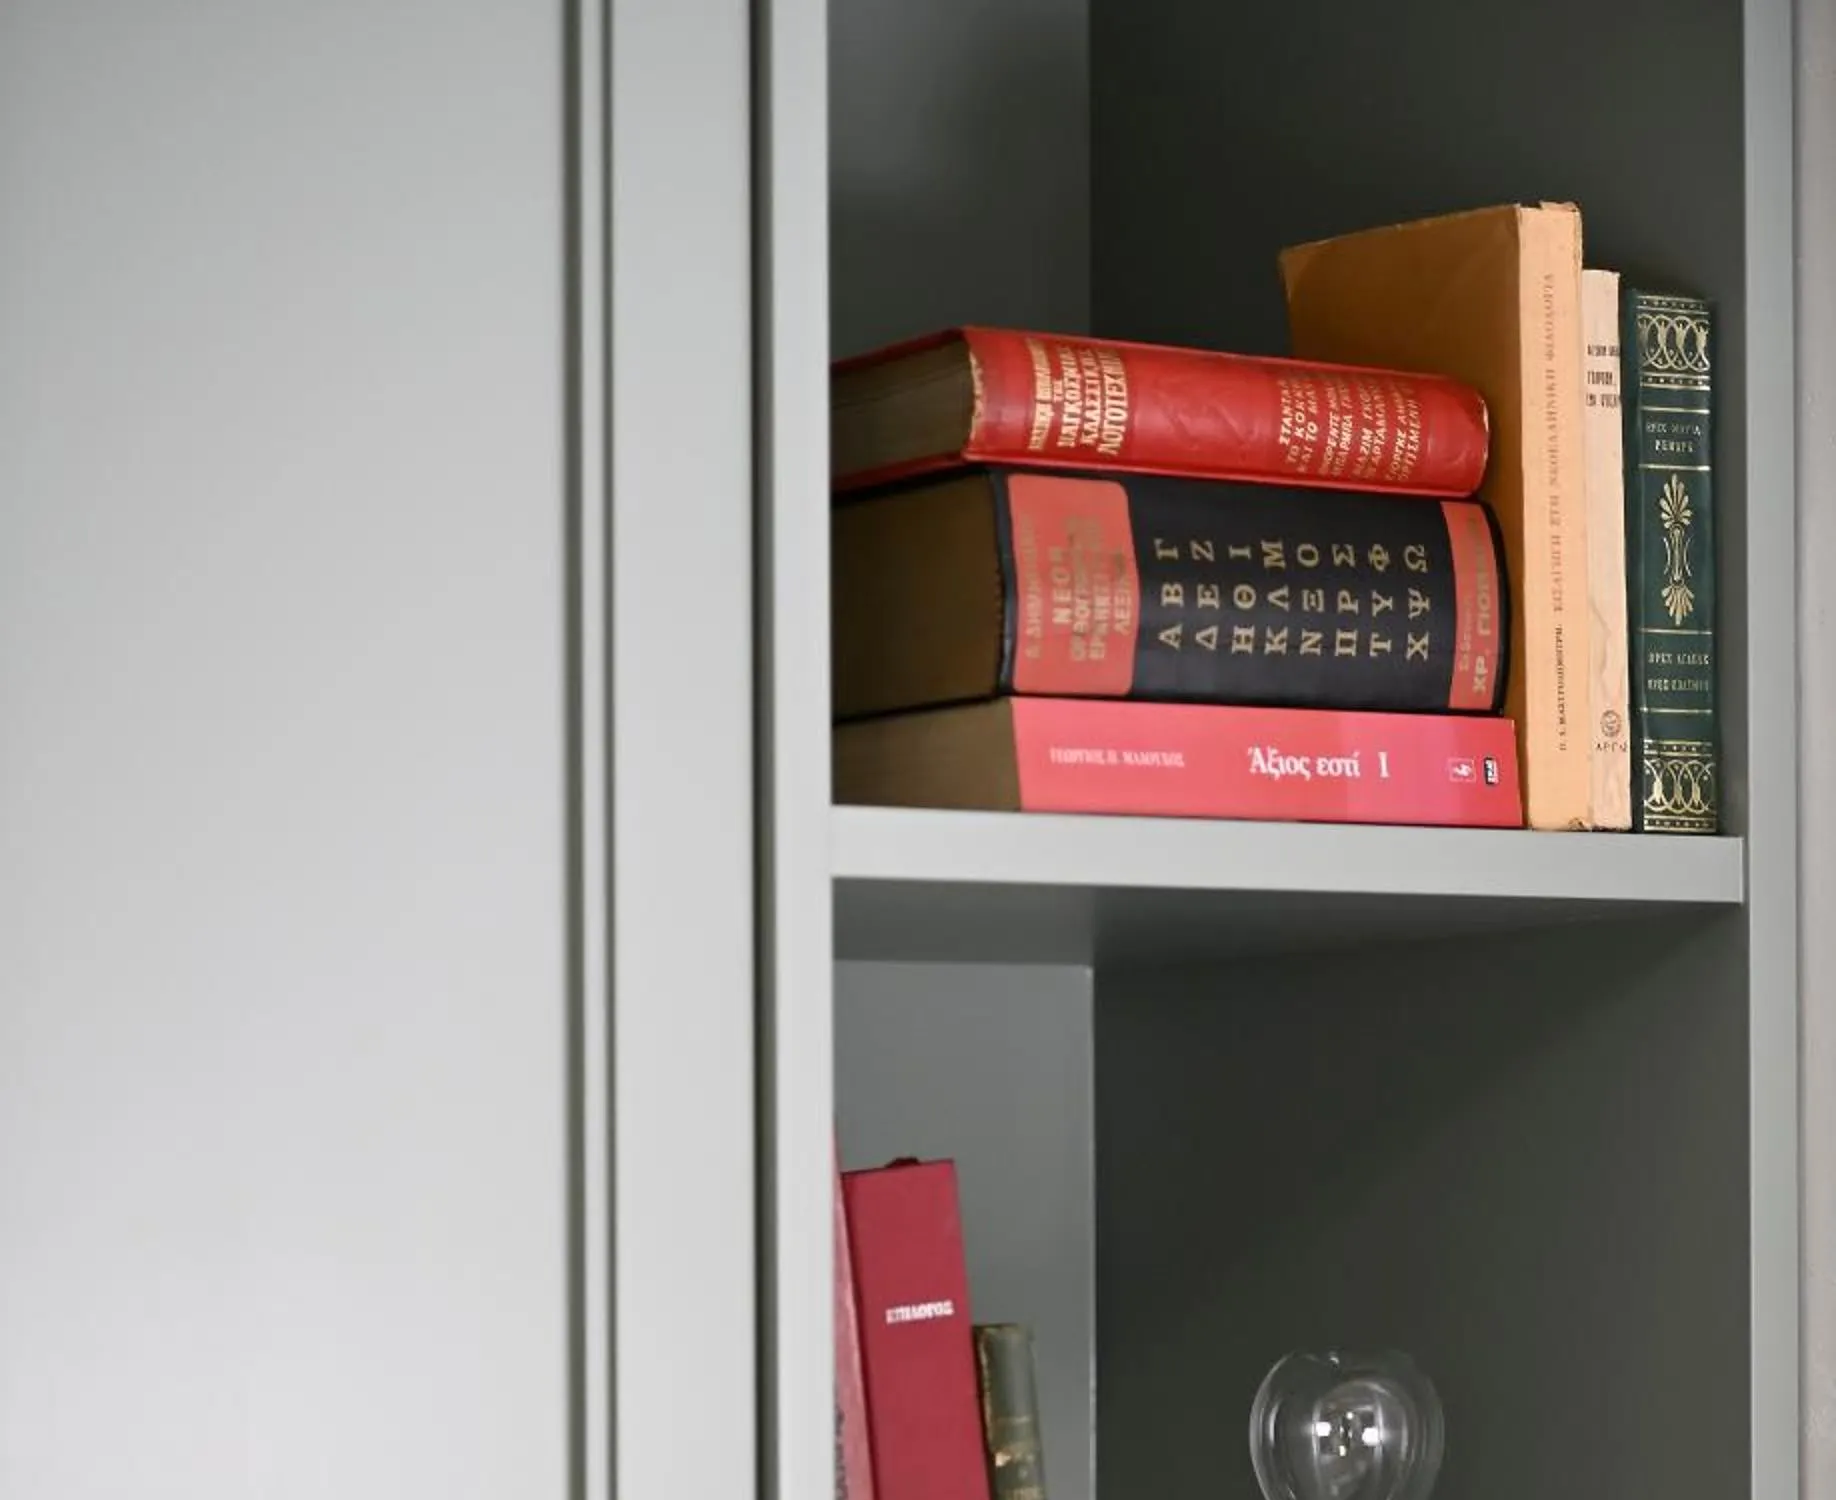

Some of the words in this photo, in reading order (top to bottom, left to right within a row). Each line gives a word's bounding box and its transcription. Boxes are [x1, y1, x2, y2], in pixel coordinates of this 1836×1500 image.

[1305, 421, 1318, 441] ΤΟ
[1154, 538, 1179, 560] Γ
[1190, 540, 1215, 562] Ζ
[1229, 545, 1251, 559] Ι
[1261, 539, 1286, 571] Μ
[1297, 543, 1320, 568] Ο
[1332, 544, 1356, 568] Σ
[1368, 544, 1391, 572] Φ
[1403, 544, 1428, 573] Ω
[1161, 582, 1184, 607] Β
[1197, 584, 1220, 610] Ε
[1233, 583, 1257, 610] Θ
[1267, 585, 1290, 612] Λ
[1302, 588, 1324, 613] Ξ
[1337, 589, 1359, 614] Ρ
[1371, 590, 1393, 617] Υ
[1408, 588, 1430, 620] Ψ
[1158, 624, 1182, 650] Α
[1195, 624, 1219, 650] Δ
[1231, 624, 1256, 655] Η
[1264, 626, 1289, 655] Κ
[1300, 629, 1323, 656] Ν
[1334, 628, 1357, 657] Π
[1369, 632, 1392, 657] Τ
[1406, 631, 1429, 662] Χ
[1315, 751, 1361, 778] εστί
